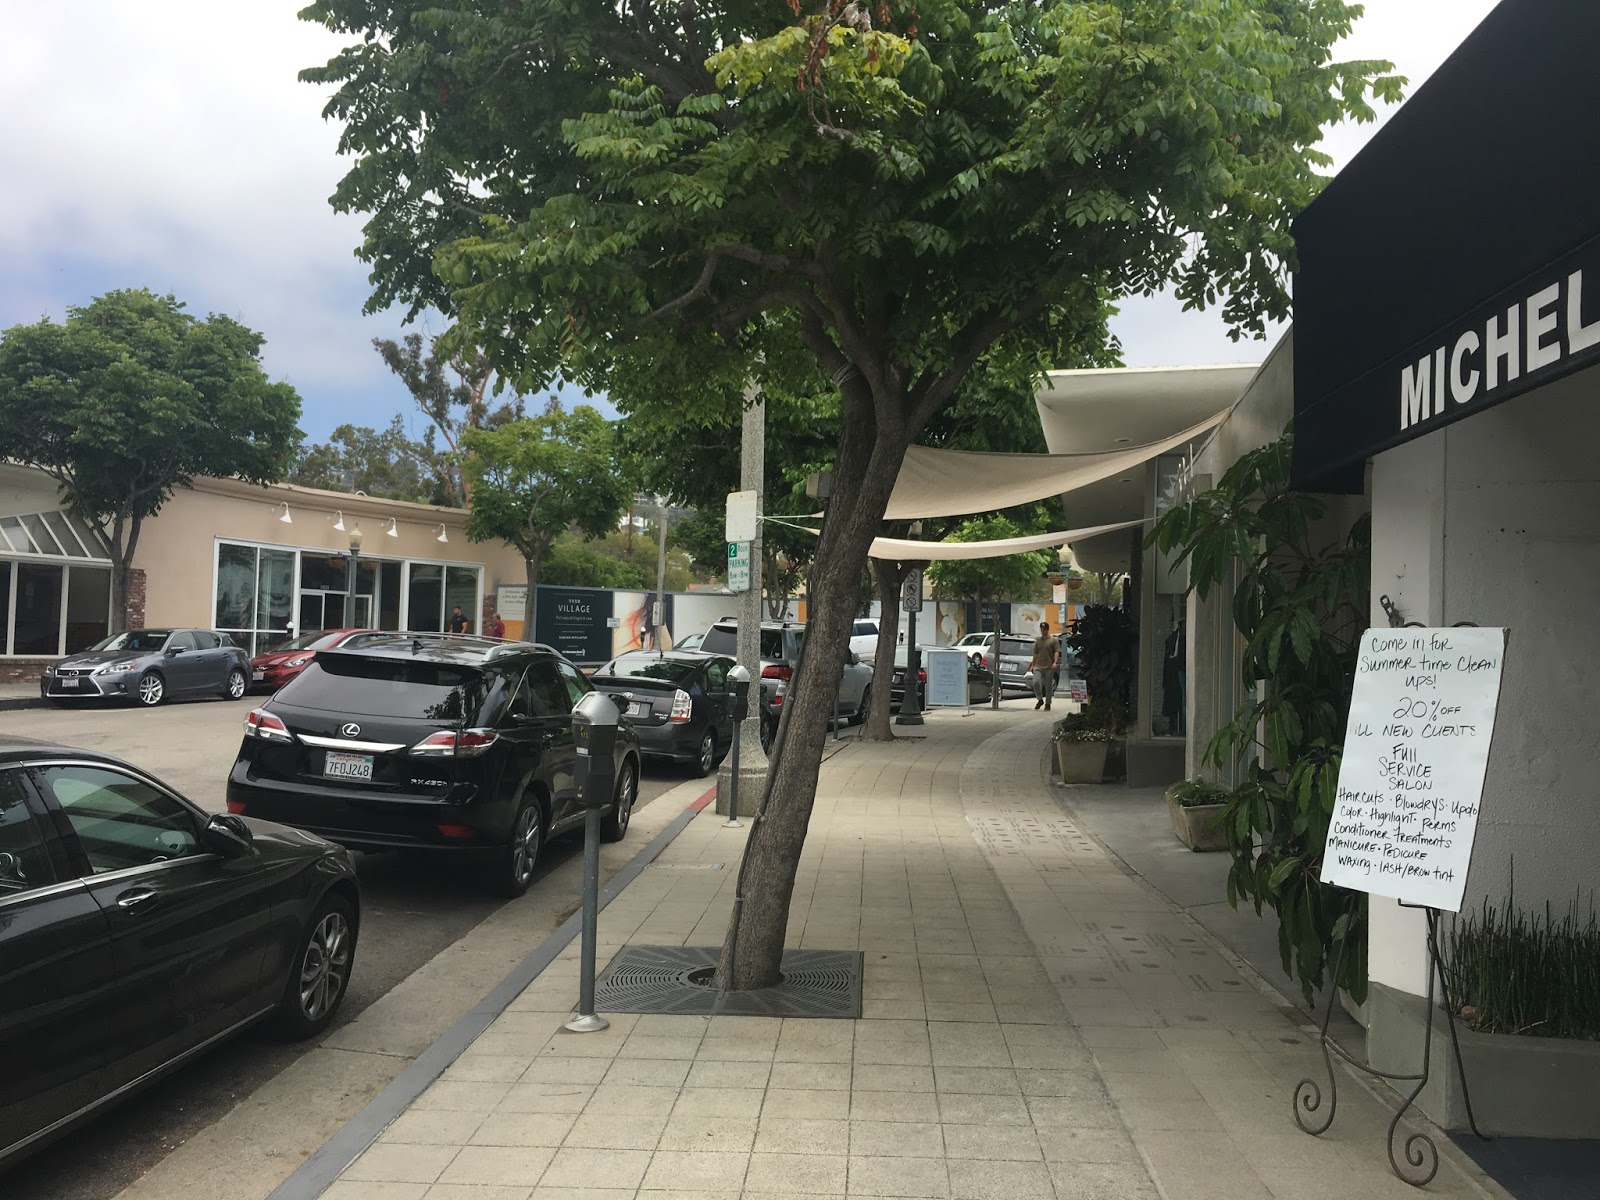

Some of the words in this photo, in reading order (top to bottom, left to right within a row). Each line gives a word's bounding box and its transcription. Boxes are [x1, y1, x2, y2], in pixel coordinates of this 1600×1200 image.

[729, 558, 749, 569] PARKING
[558, 604, 591, 613] VILLAGE
[1372, 636, 1407, 653] Come
[1412, 637, 1425, 652] in
[1419, 657, 1452, 672] time
[1393, 697, 1441, 722] 20%
[1440, 706, 1462, 715] OFF
[1382, 724, 1413, 738] NEW
[1421, 723, 1477, 739] CLIENTS
[1379, 756, 1432, 778] SERVICE
[1388, 776, 1433, 791] SALON
[1328, 838, 1378, 853] MANICURE
[1383, 843, 1428, 861] PEDICURE
